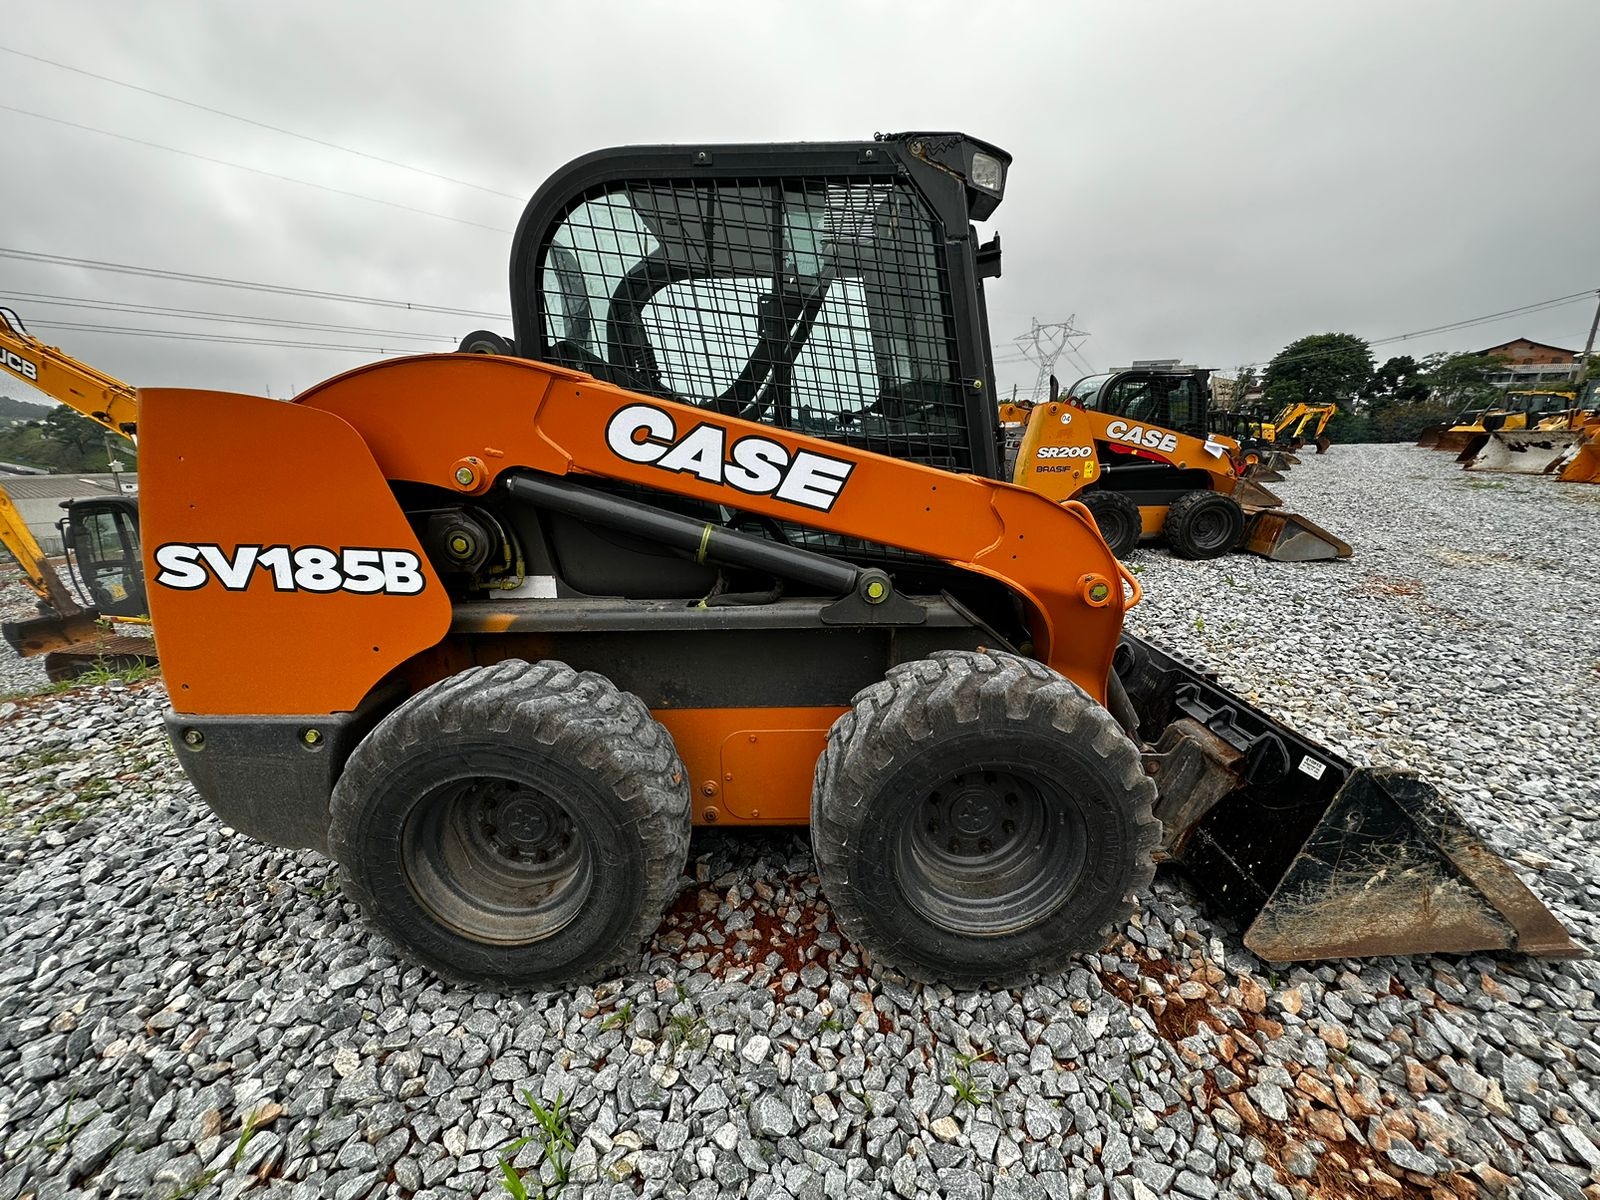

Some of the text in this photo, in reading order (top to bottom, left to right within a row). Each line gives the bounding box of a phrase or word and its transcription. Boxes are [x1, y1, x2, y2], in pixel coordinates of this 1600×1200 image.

[0, 348, 37, 380] JCB
[1036, 446, 1092, 458] SR200
[1106, 421, 1177, 452] CASE
[606, 404, 855, 511] CASE
[1036, 465, 1071, 473] BRASIF
[154, 543, 425, 595] SV185B
